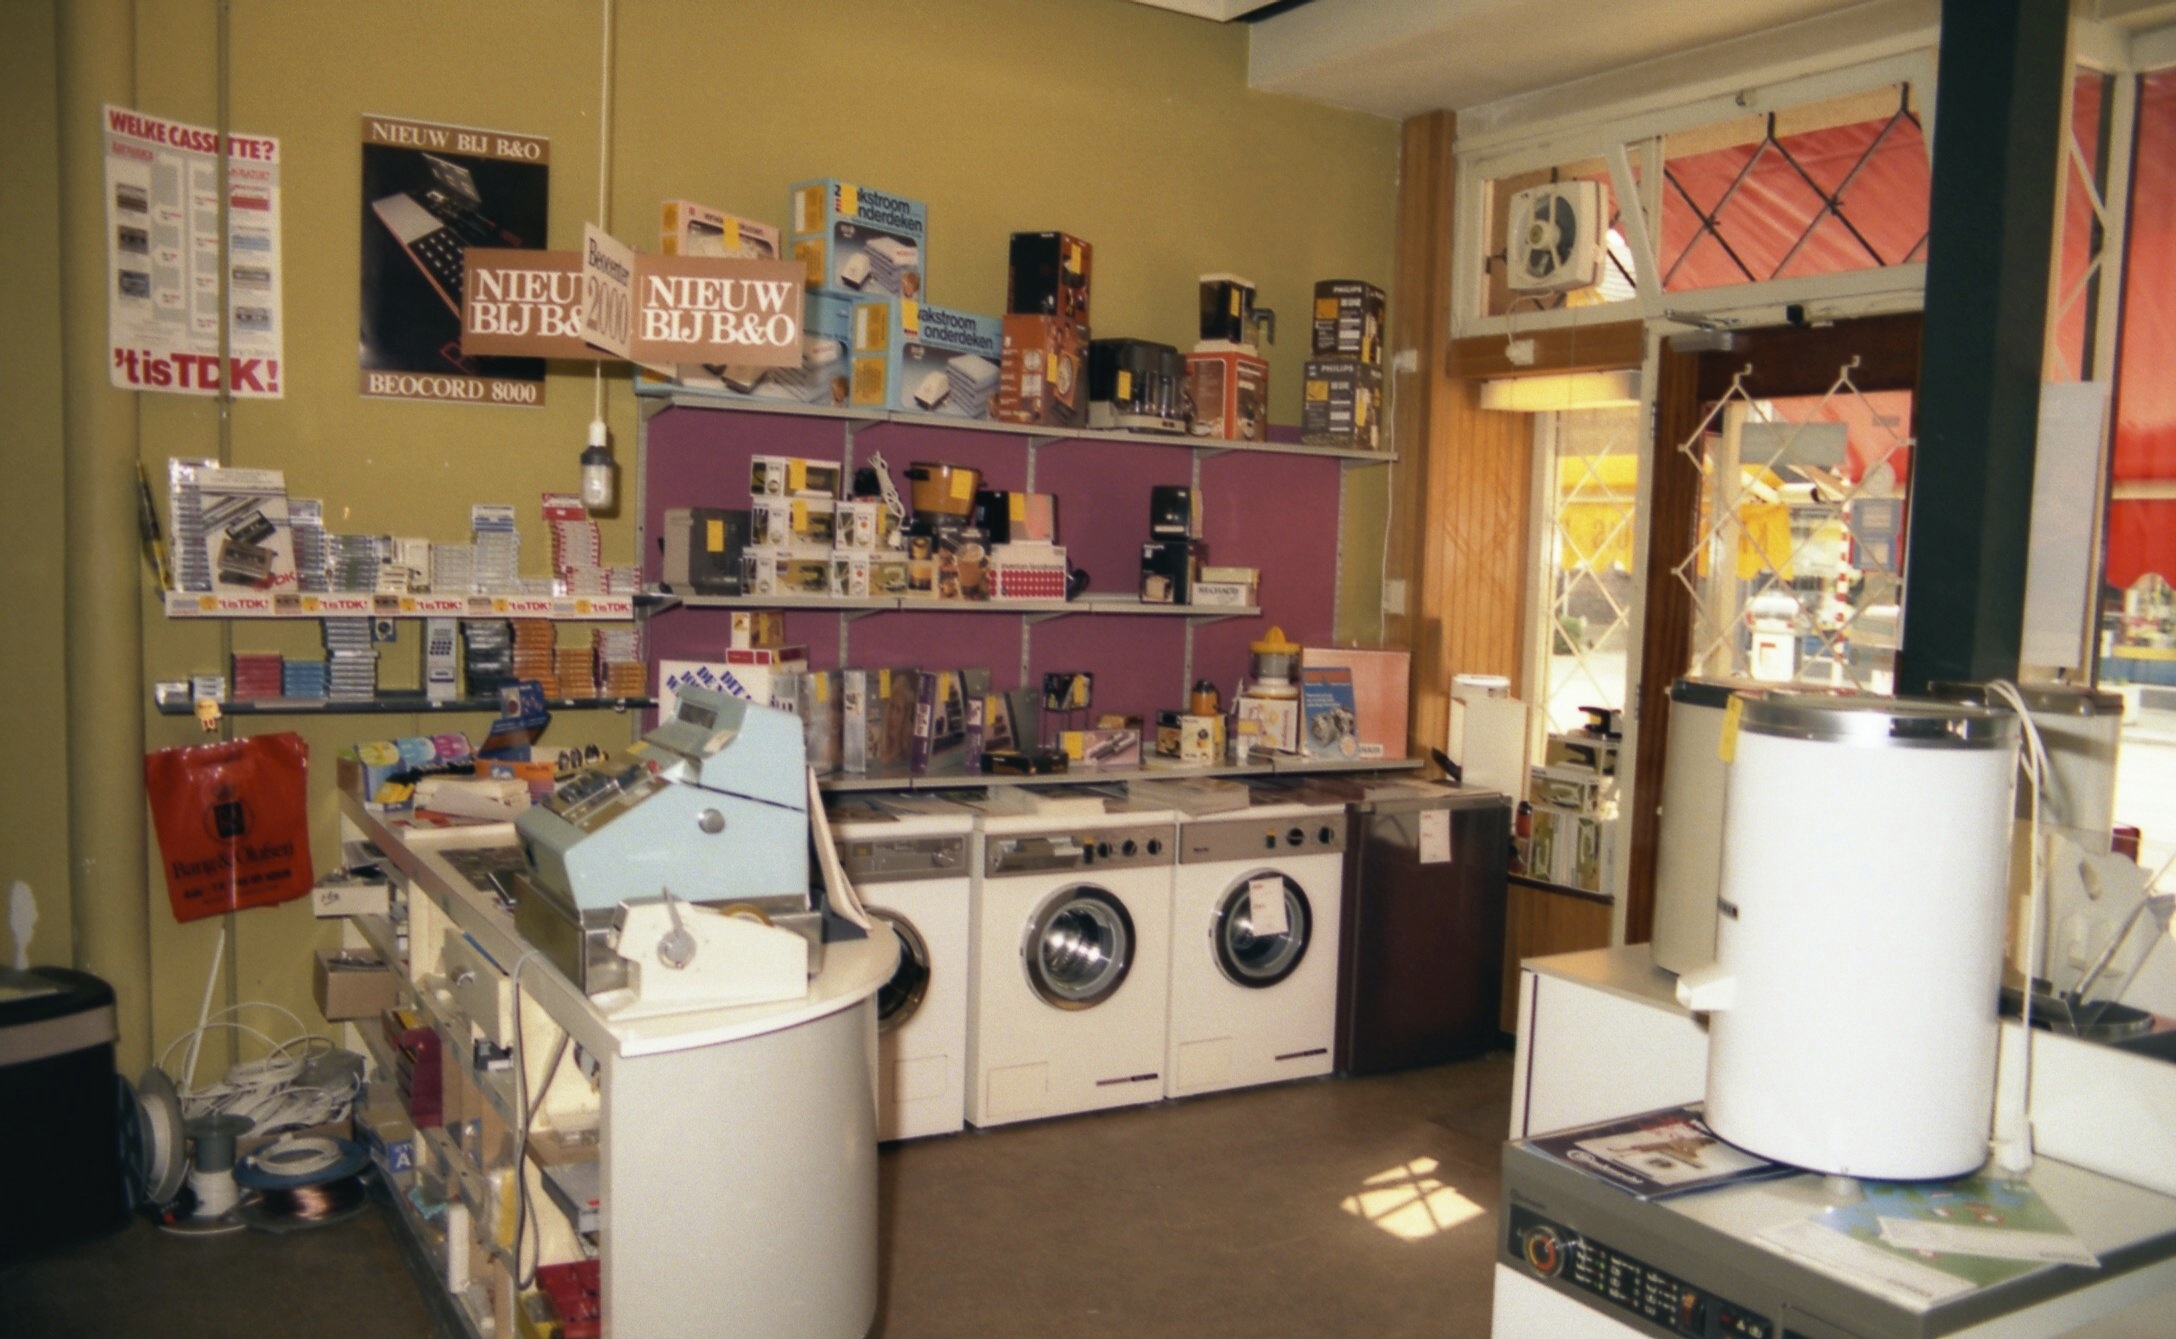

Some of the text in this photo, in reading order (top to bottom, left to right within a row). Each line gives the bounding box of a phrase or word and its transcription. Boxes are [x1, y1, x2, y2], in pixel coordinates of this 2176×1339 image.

[109, 110, 167, 145] WELKE
[371, 122, 541, 160] NIEUW BIJ B&O
[858, 205, 922, 232] nderdeken
[475, 268, 584, 303] NIEU
[647, 275, 792, 313] NIEUW
[470, 303, 585, 338] BIJ B&
[586, 275, 629, 345] 2000
[641, 309, 795, 347] BIJ B&O
[924, 325, 993, 350] onderdeken
[368, 373, 537, 403] BEOCORD 8000
